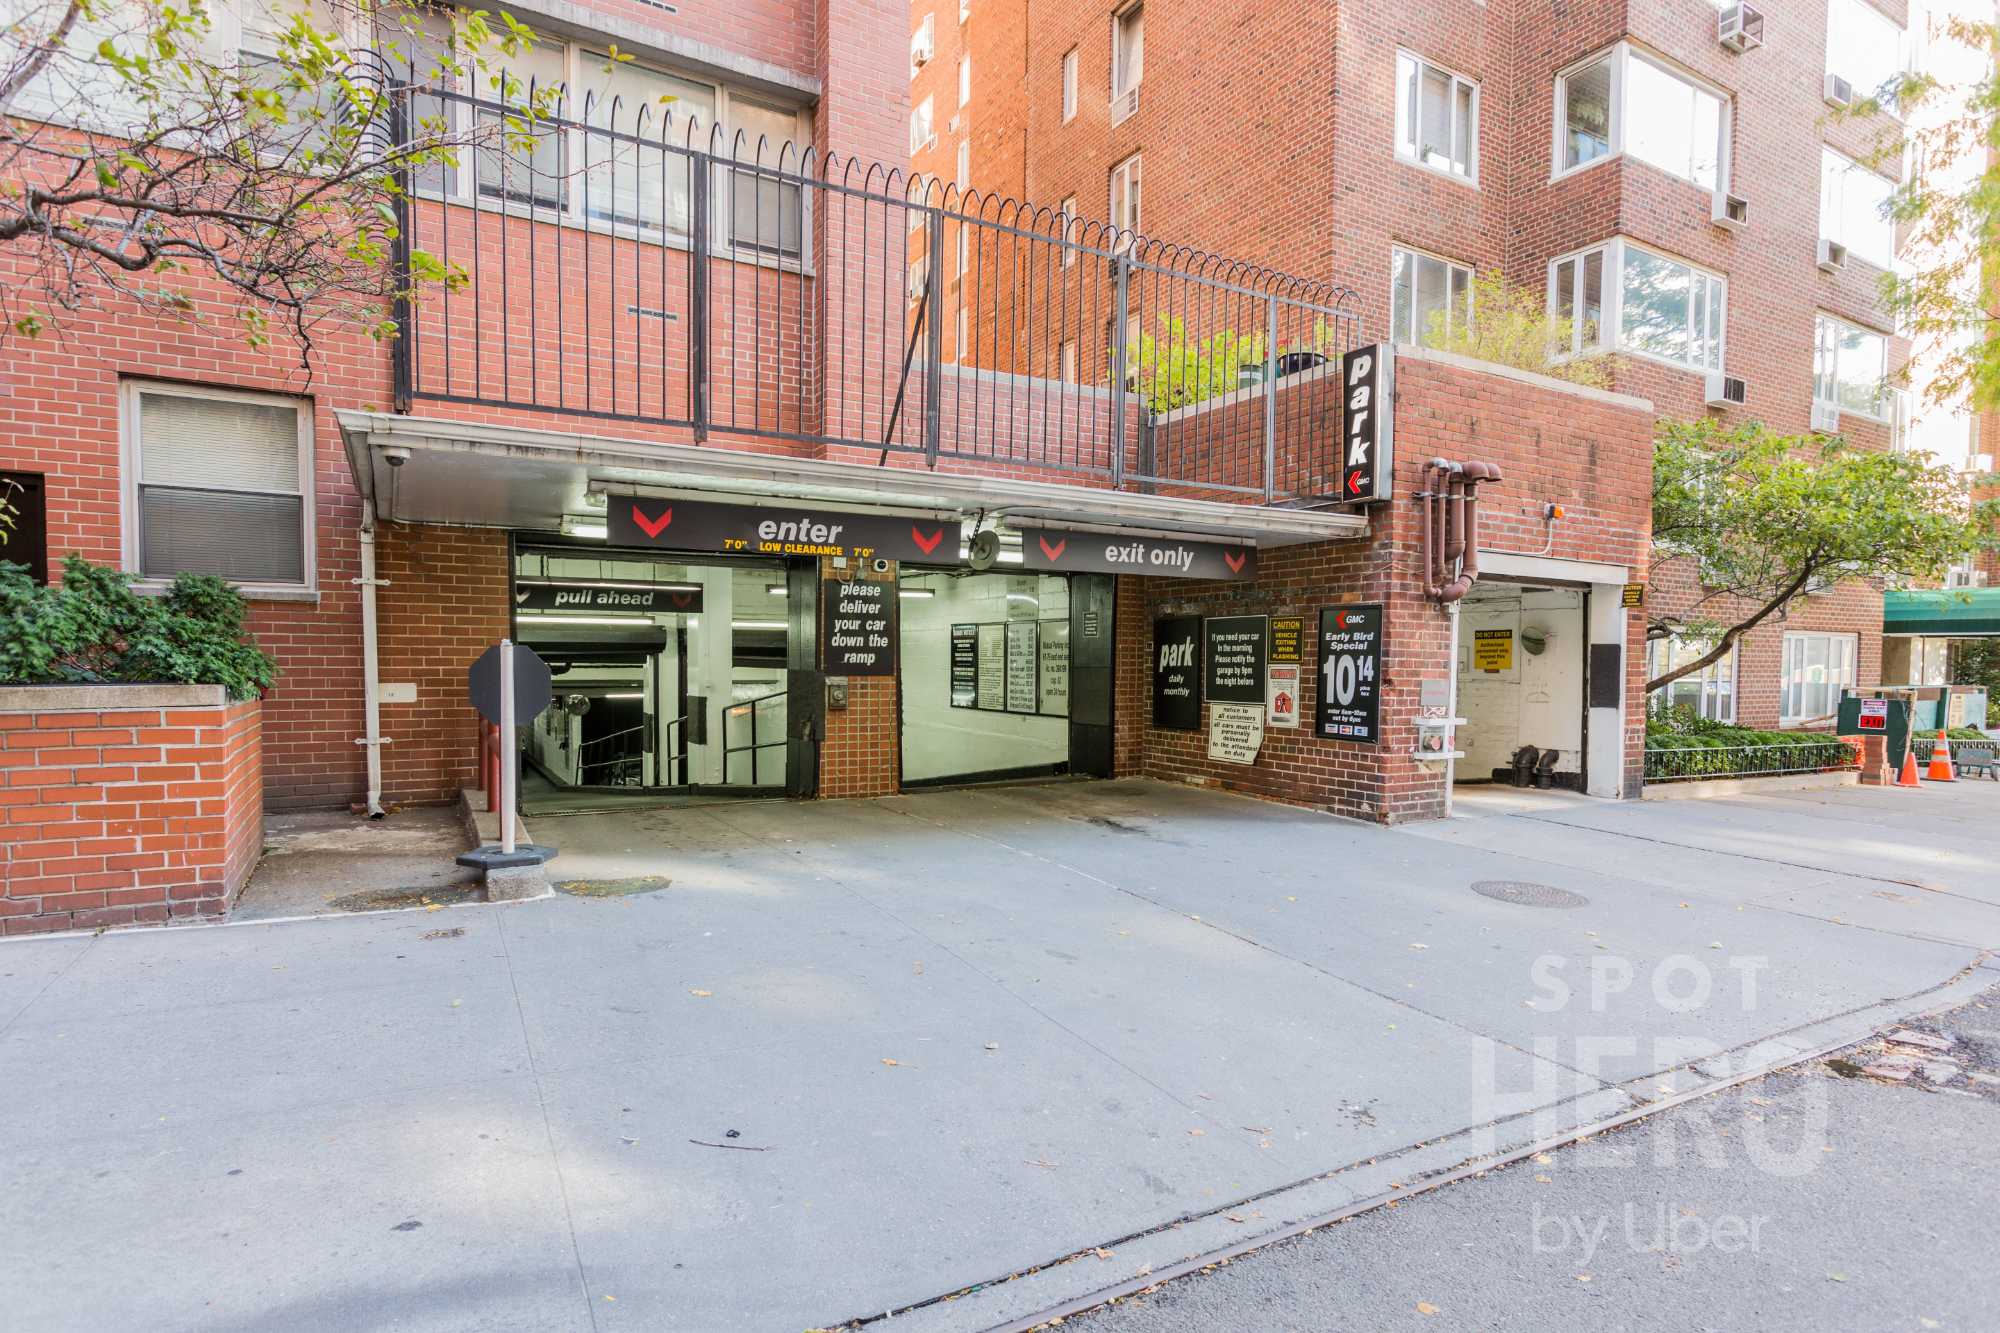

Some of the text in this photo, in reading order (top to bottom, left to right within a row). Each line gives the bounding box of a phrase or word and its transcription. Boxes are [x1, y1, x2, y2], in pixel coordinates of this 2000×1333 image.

[758, 518, 843, 543] enter
[760, 541, 782, 552] LOW
[784, 543, 843, 556] CLEARANCE
[1105, 543, 1194, 572] exit only
[840, 582, 881, 597] please
[554, 589, 654, 606] pull ahead
[840, 600, 881, 614] deliver
[1272, 620, 1300, 629] CAUTION
[1346, 615, 1365, 623] GMC
[834, 619, 886, 632] your car
[831, 633, 888, 647] down the
[1216, 634, 1225, 643] you
[1226, 632, 1238, 640] need
[1239, 633, 1250, 642] your
[1325, 632, 1374, 642] Early Bird
[1223, 644, 1231, 652] the
[1232, 643, 1252, 653] morning
[1330, 641, 1368, 651] Special
[844, 652, 875, 666] ramp
[1159, 635, 1195, 672] park
[1215, 654, 1255, 665] Please notify the
[1216, 667, 1233, 676] garage
[1234, 666, 1240, 676] by
[1168, 674, 1184, 684] daily
[1215, 677, 1254, 687] the night before
[1323, 654, 1374, 706] 10 14
[1163, 687, 1190, 696] monthly
